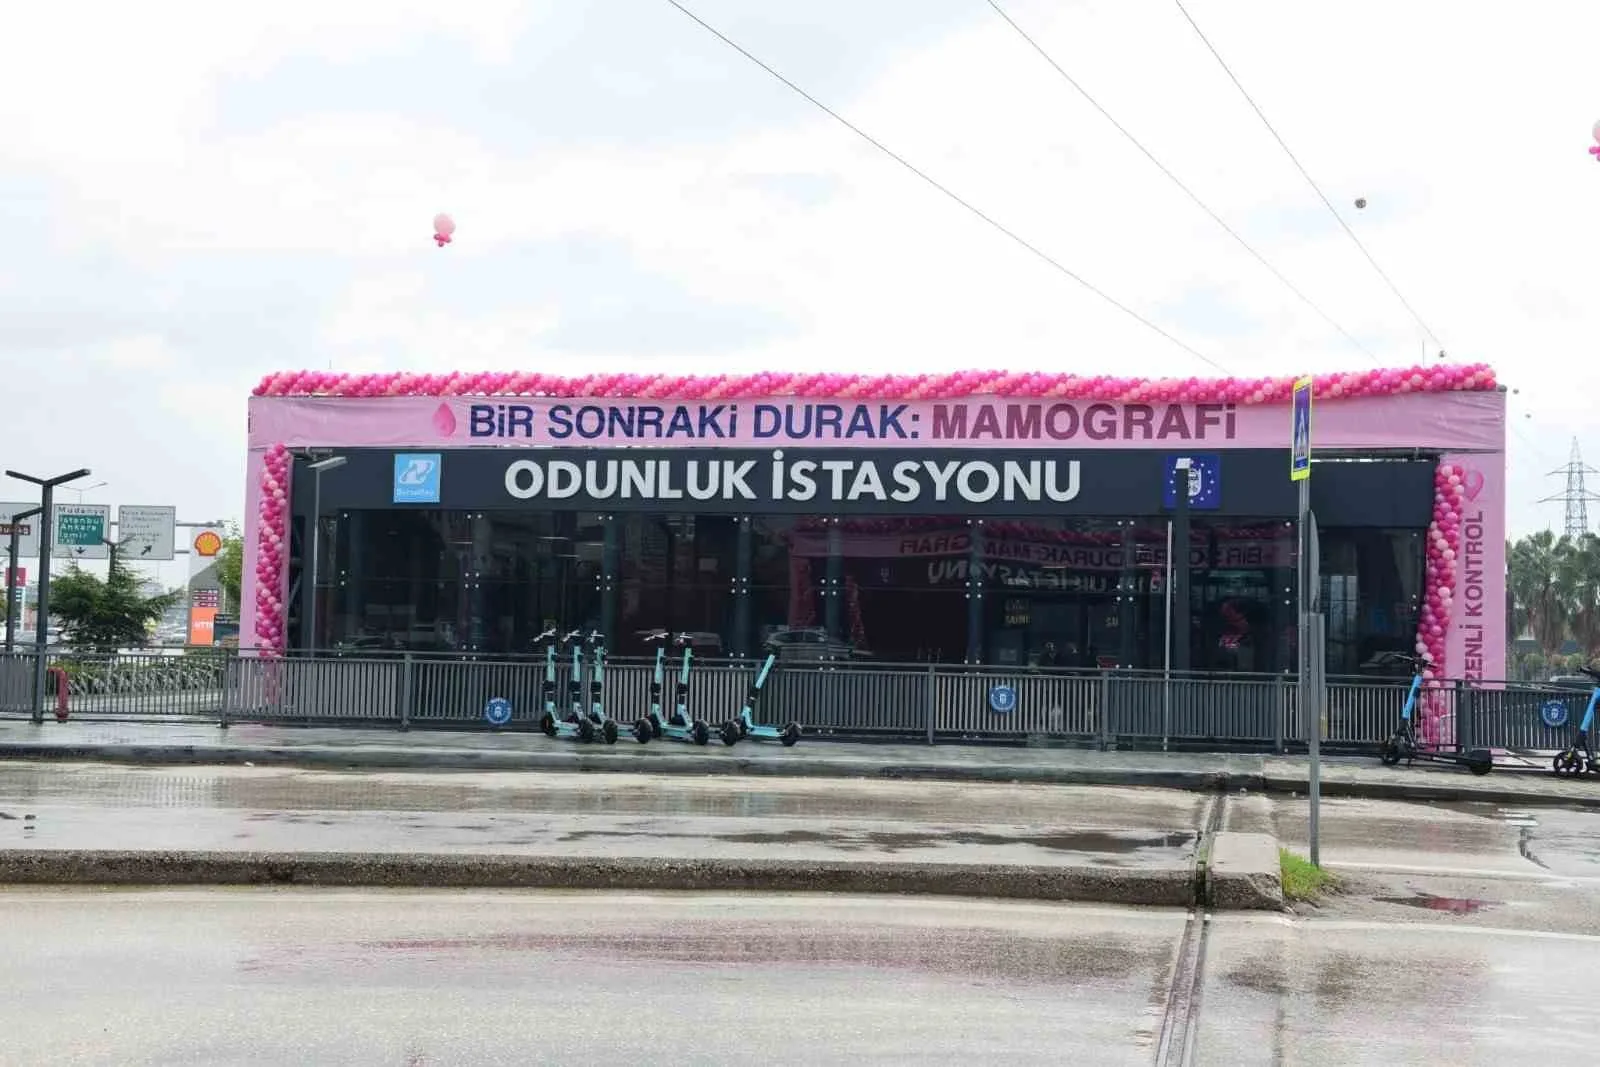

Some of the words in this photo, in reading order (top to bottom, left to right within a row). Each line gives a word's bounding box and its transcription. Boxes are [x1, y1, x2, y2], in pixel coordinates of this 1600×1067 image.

[753, 404, 921, 440] DURAK:
[504, 460, 757, 501] ODUNLUK
[771, 450, 1081, 503] İSTASYONU
[1464, 510, 1484, 617] KONTROL
